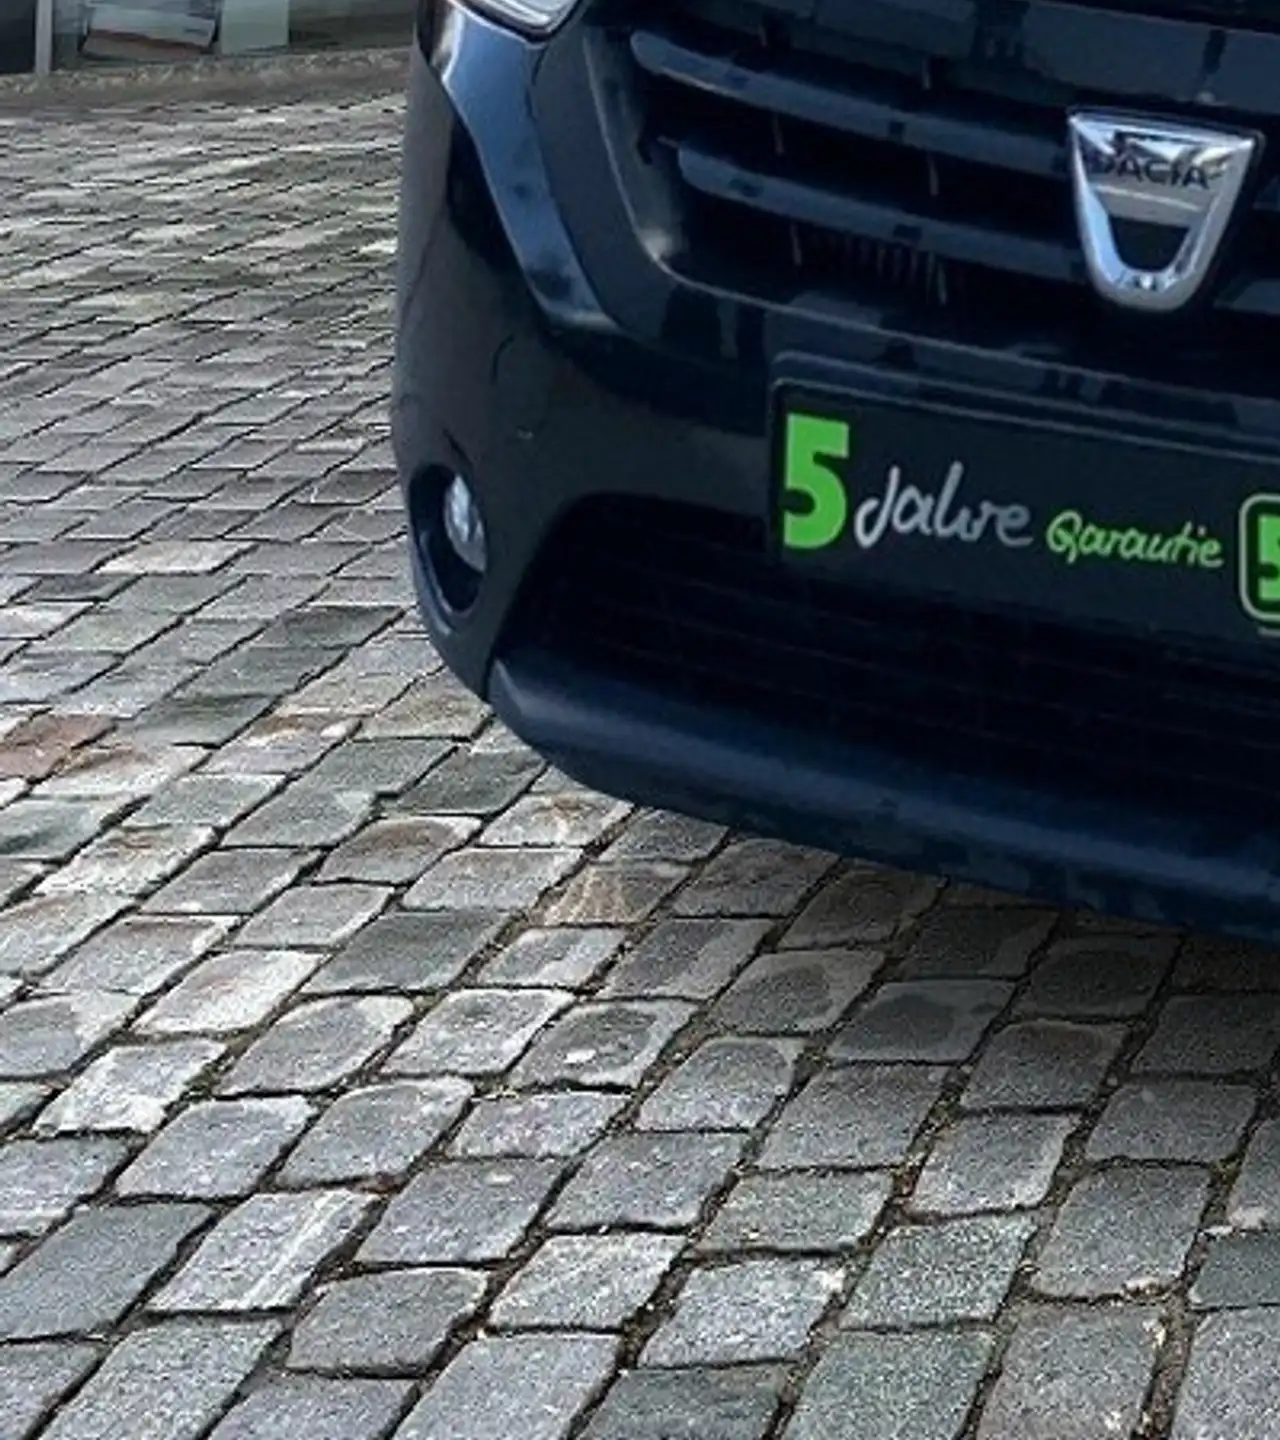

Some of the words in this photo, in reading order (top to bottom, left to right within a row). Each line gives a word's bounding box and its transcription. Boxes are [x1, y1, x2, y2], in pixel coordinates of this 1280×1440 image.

[781, 411, 850, 550] 5
[853, 461, 1033, 549] Jahre
[1045, 509, 1226, 570] Garantie
